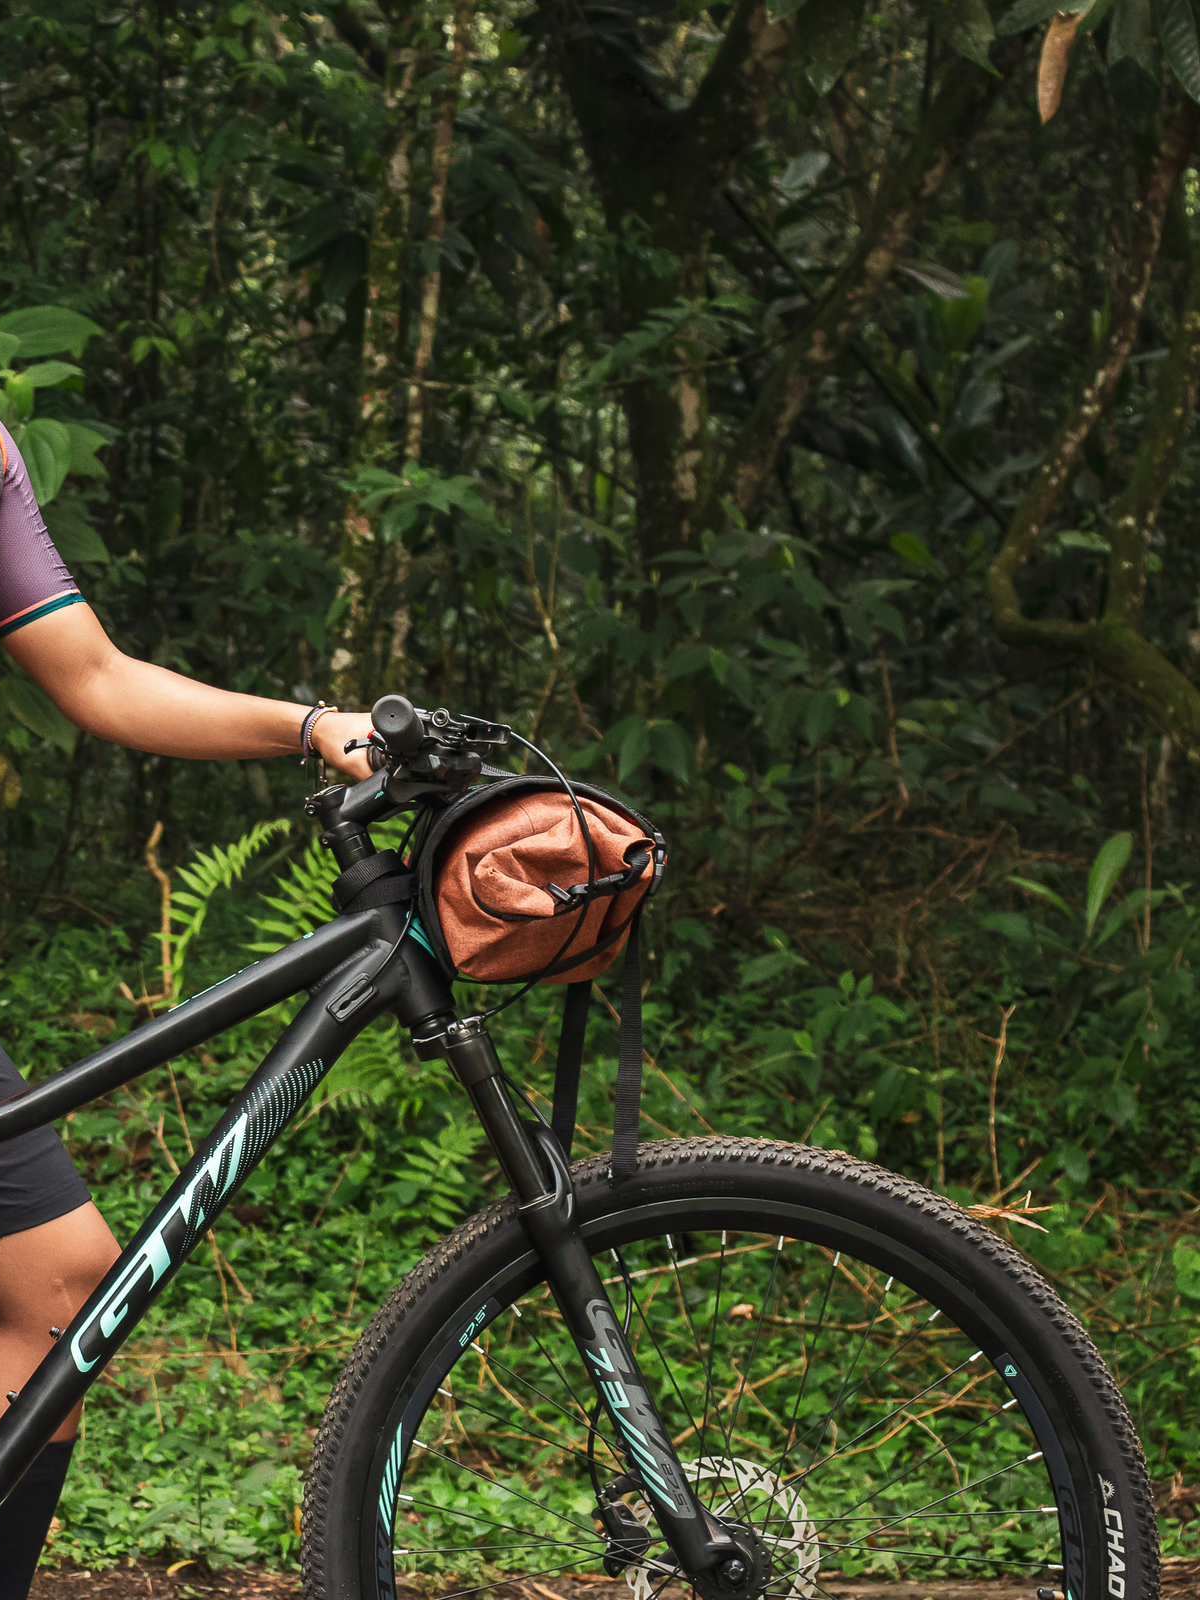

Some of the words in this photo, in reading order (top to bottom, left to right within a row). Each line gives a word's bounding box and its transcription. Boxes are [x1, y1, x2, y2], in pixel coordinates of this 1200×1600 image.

[459, 1304, 487, 1347] 27.5"
[585, 1347, 630, 1409] 7.3
[661, 1463, 691, 1512] 27.5"
[1104, 1508, 1125, 1599] CHAO
